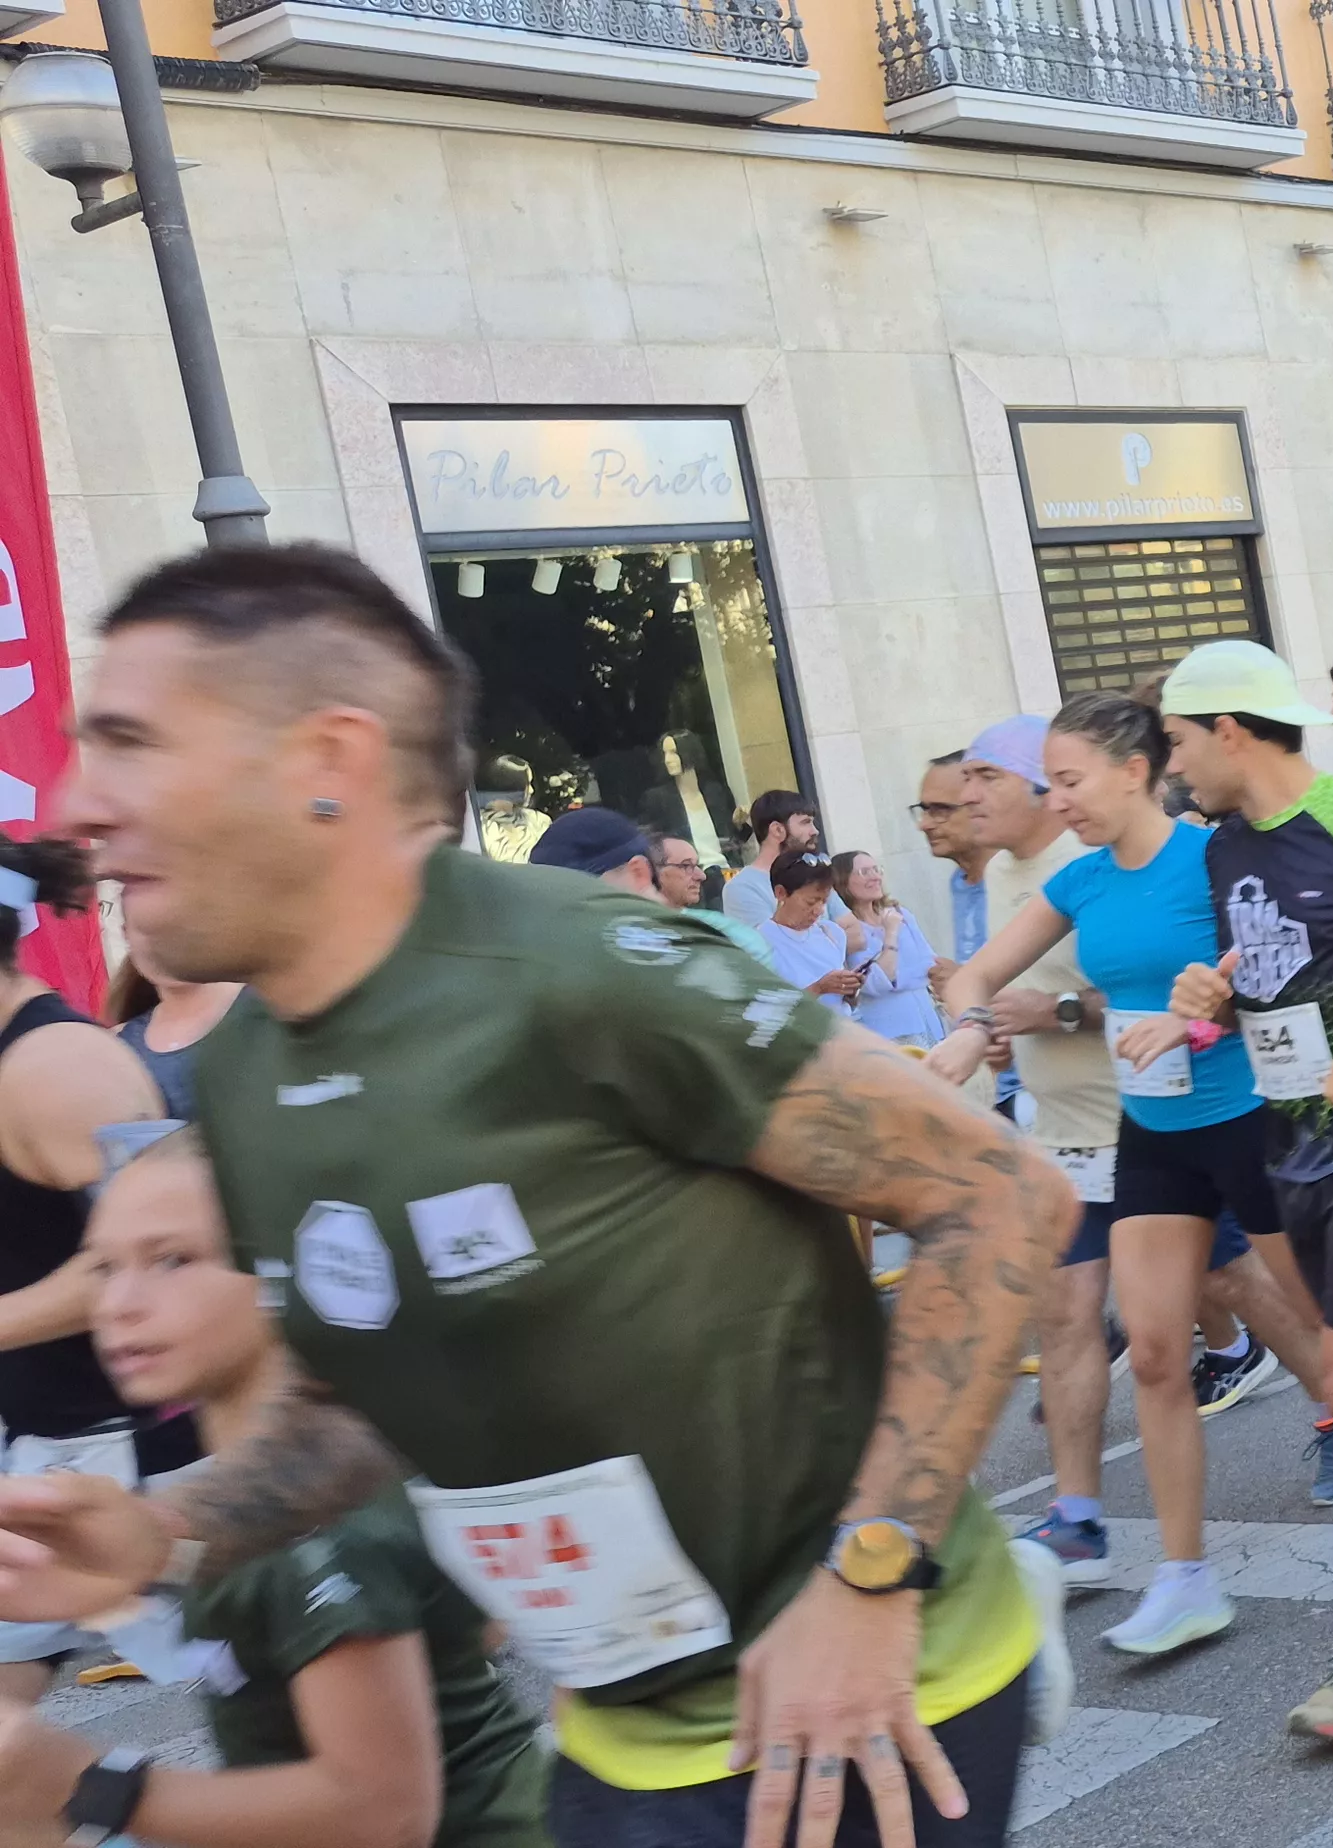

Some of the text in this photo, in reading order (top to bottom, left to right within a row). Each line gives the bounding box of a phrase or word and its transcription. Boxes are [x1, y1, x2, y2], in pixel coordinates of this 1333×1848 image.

[427, 448, 733, 502] Pilar Prieto
[1042, 491, 1245, 522] www.pilarprieto.es
